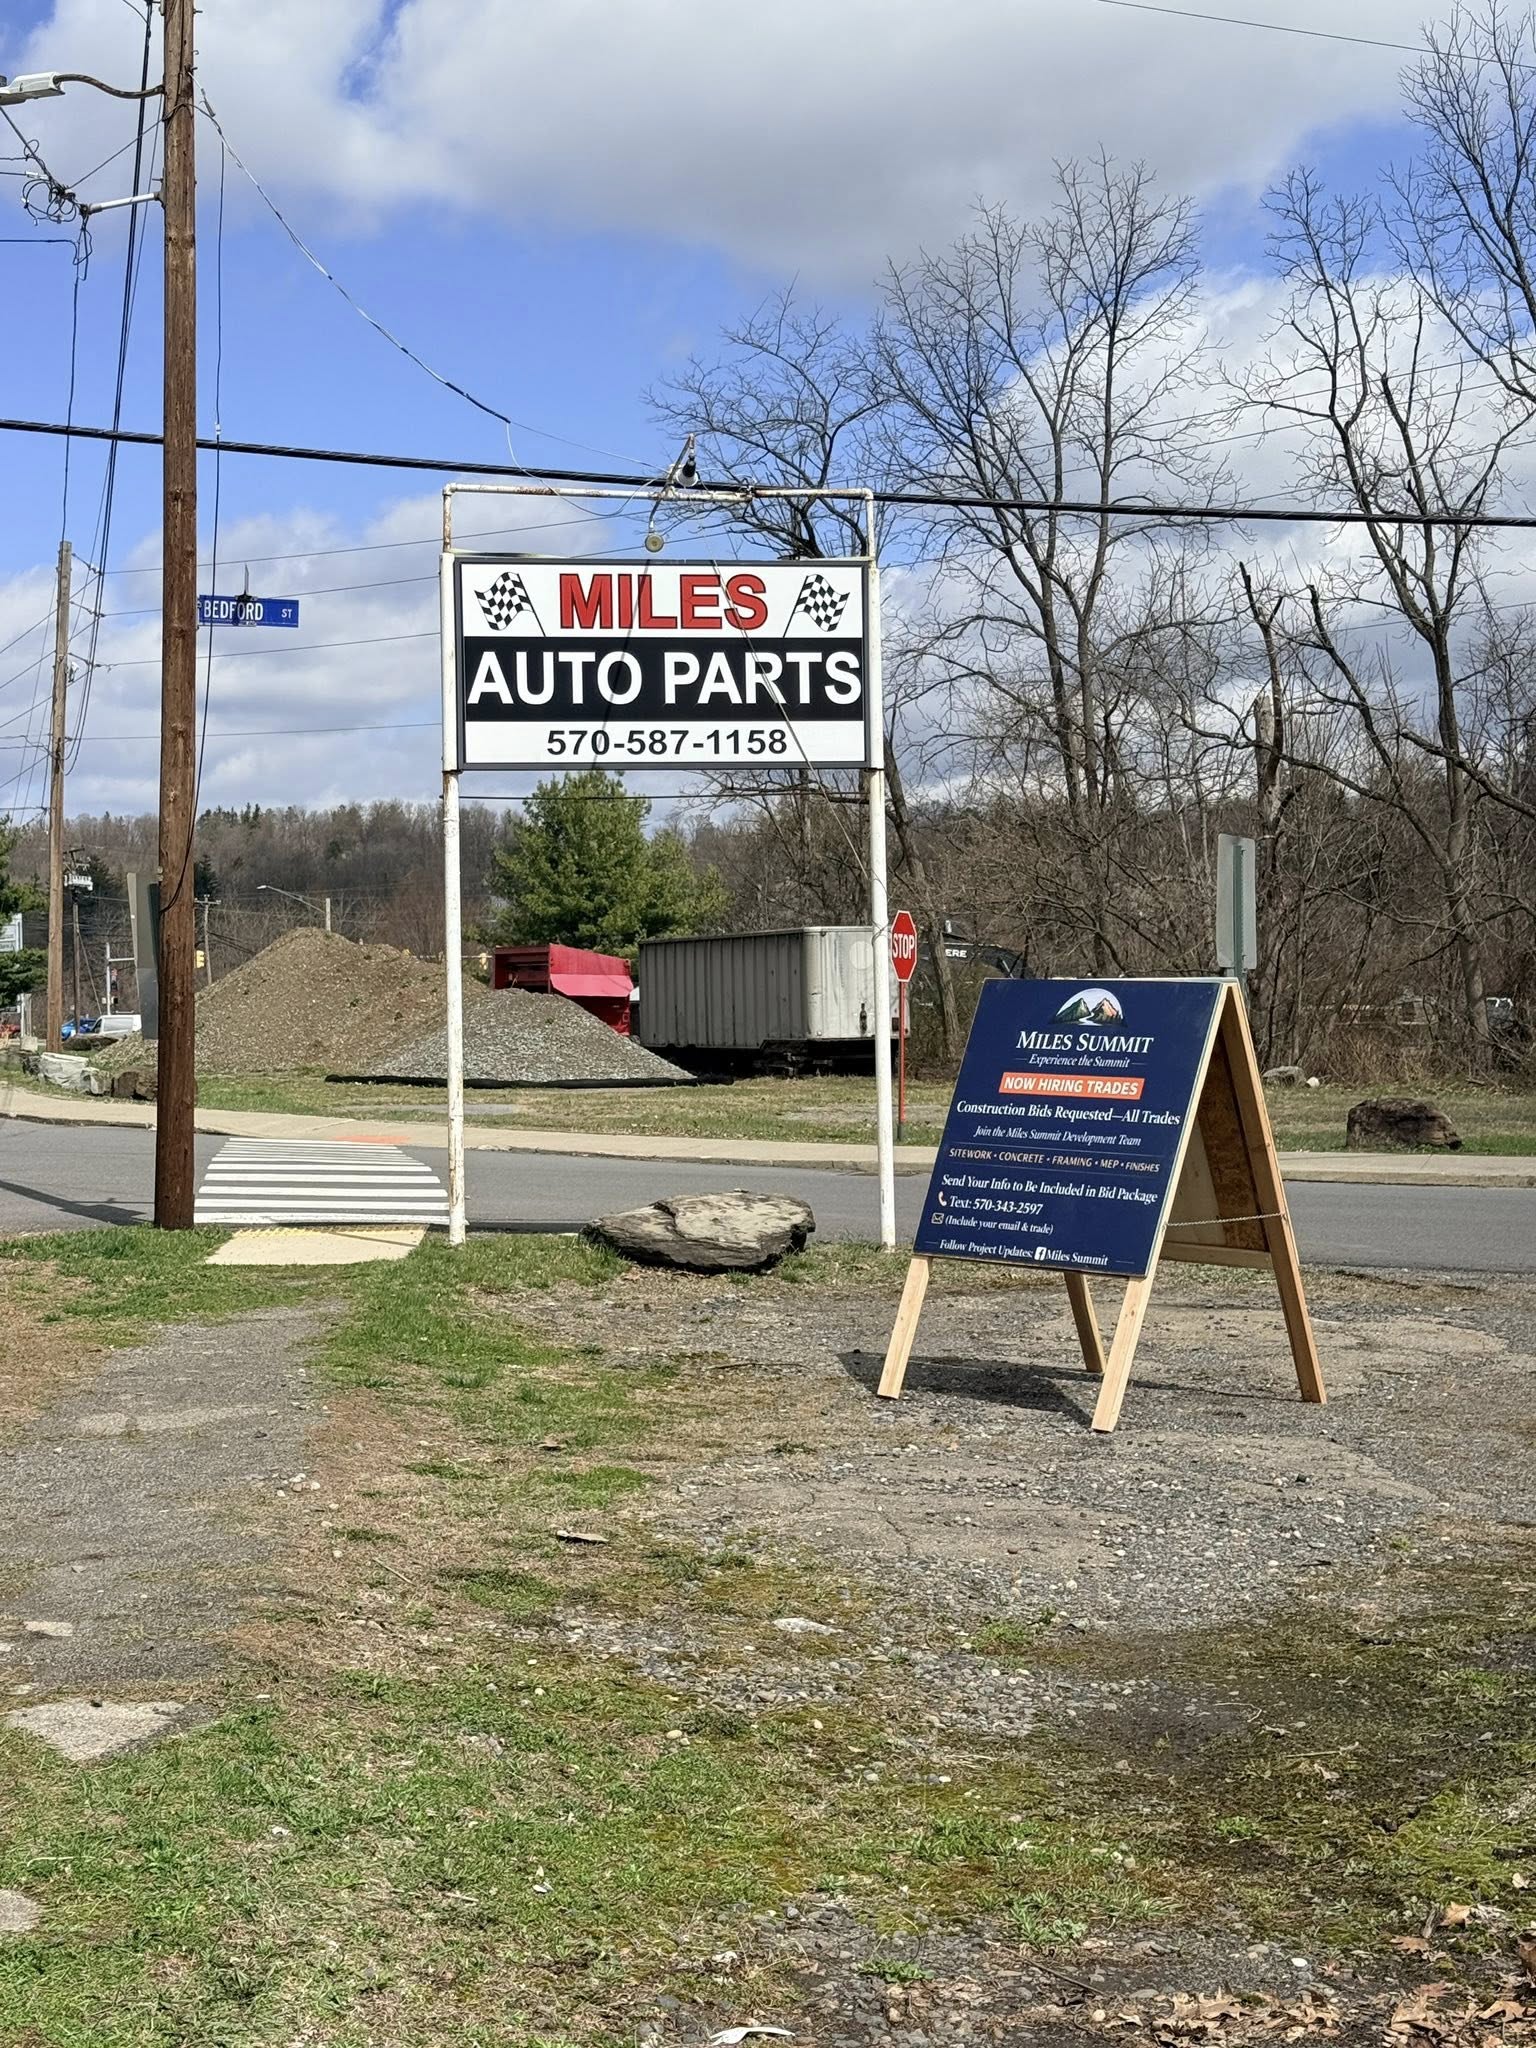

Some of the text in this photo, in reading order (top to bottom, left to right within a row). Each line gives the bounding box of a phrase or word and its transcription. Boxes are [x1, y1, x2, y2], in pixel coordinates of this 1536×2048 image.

[203, 600, 293, 621] BEDFORD ST
[559, 573, 768, 630] MILES
[467, 651, 862, 705] AUTO PARTS
[547, 729, 788, 755] 570-587-1158
[892, 933, 915, 959] STOP
[945, 949, 967, 958] ERE
[1016, 1031, 1154, 1054] MILES SUMMIT
[1029, 1053, 1130, 1068] Experience the Summit
[1003, 1077, 1139, 1096] NOW HIRING TRADES
[957, 1101, 1026, 1116] Construction
[1027, 1104, 1053, 1118] Bids
[1141, 1110, 1181, 1125] Trades
[973, 1126, 1142, 1146] Join the Miles Summit Development Team
[949, 1148, 1160, 1173] SITEWORK CONCRETE FRAMING MEP FINISHES
[942, 1174, 1158, 1205] Send Your Info to Be Included in Bid Package
[949, 1195, 1044, 1215] Text: 570-343-2597
[945, 1215, 1054, 1236] (Include your email & trade)
[939, 1239, 967, 1251] Follow
[968, 1241, 998, 1256] Project
[1045, 1249, 1071, 1261] Miles
[1071, 1251, 1109, 1266] Summit
